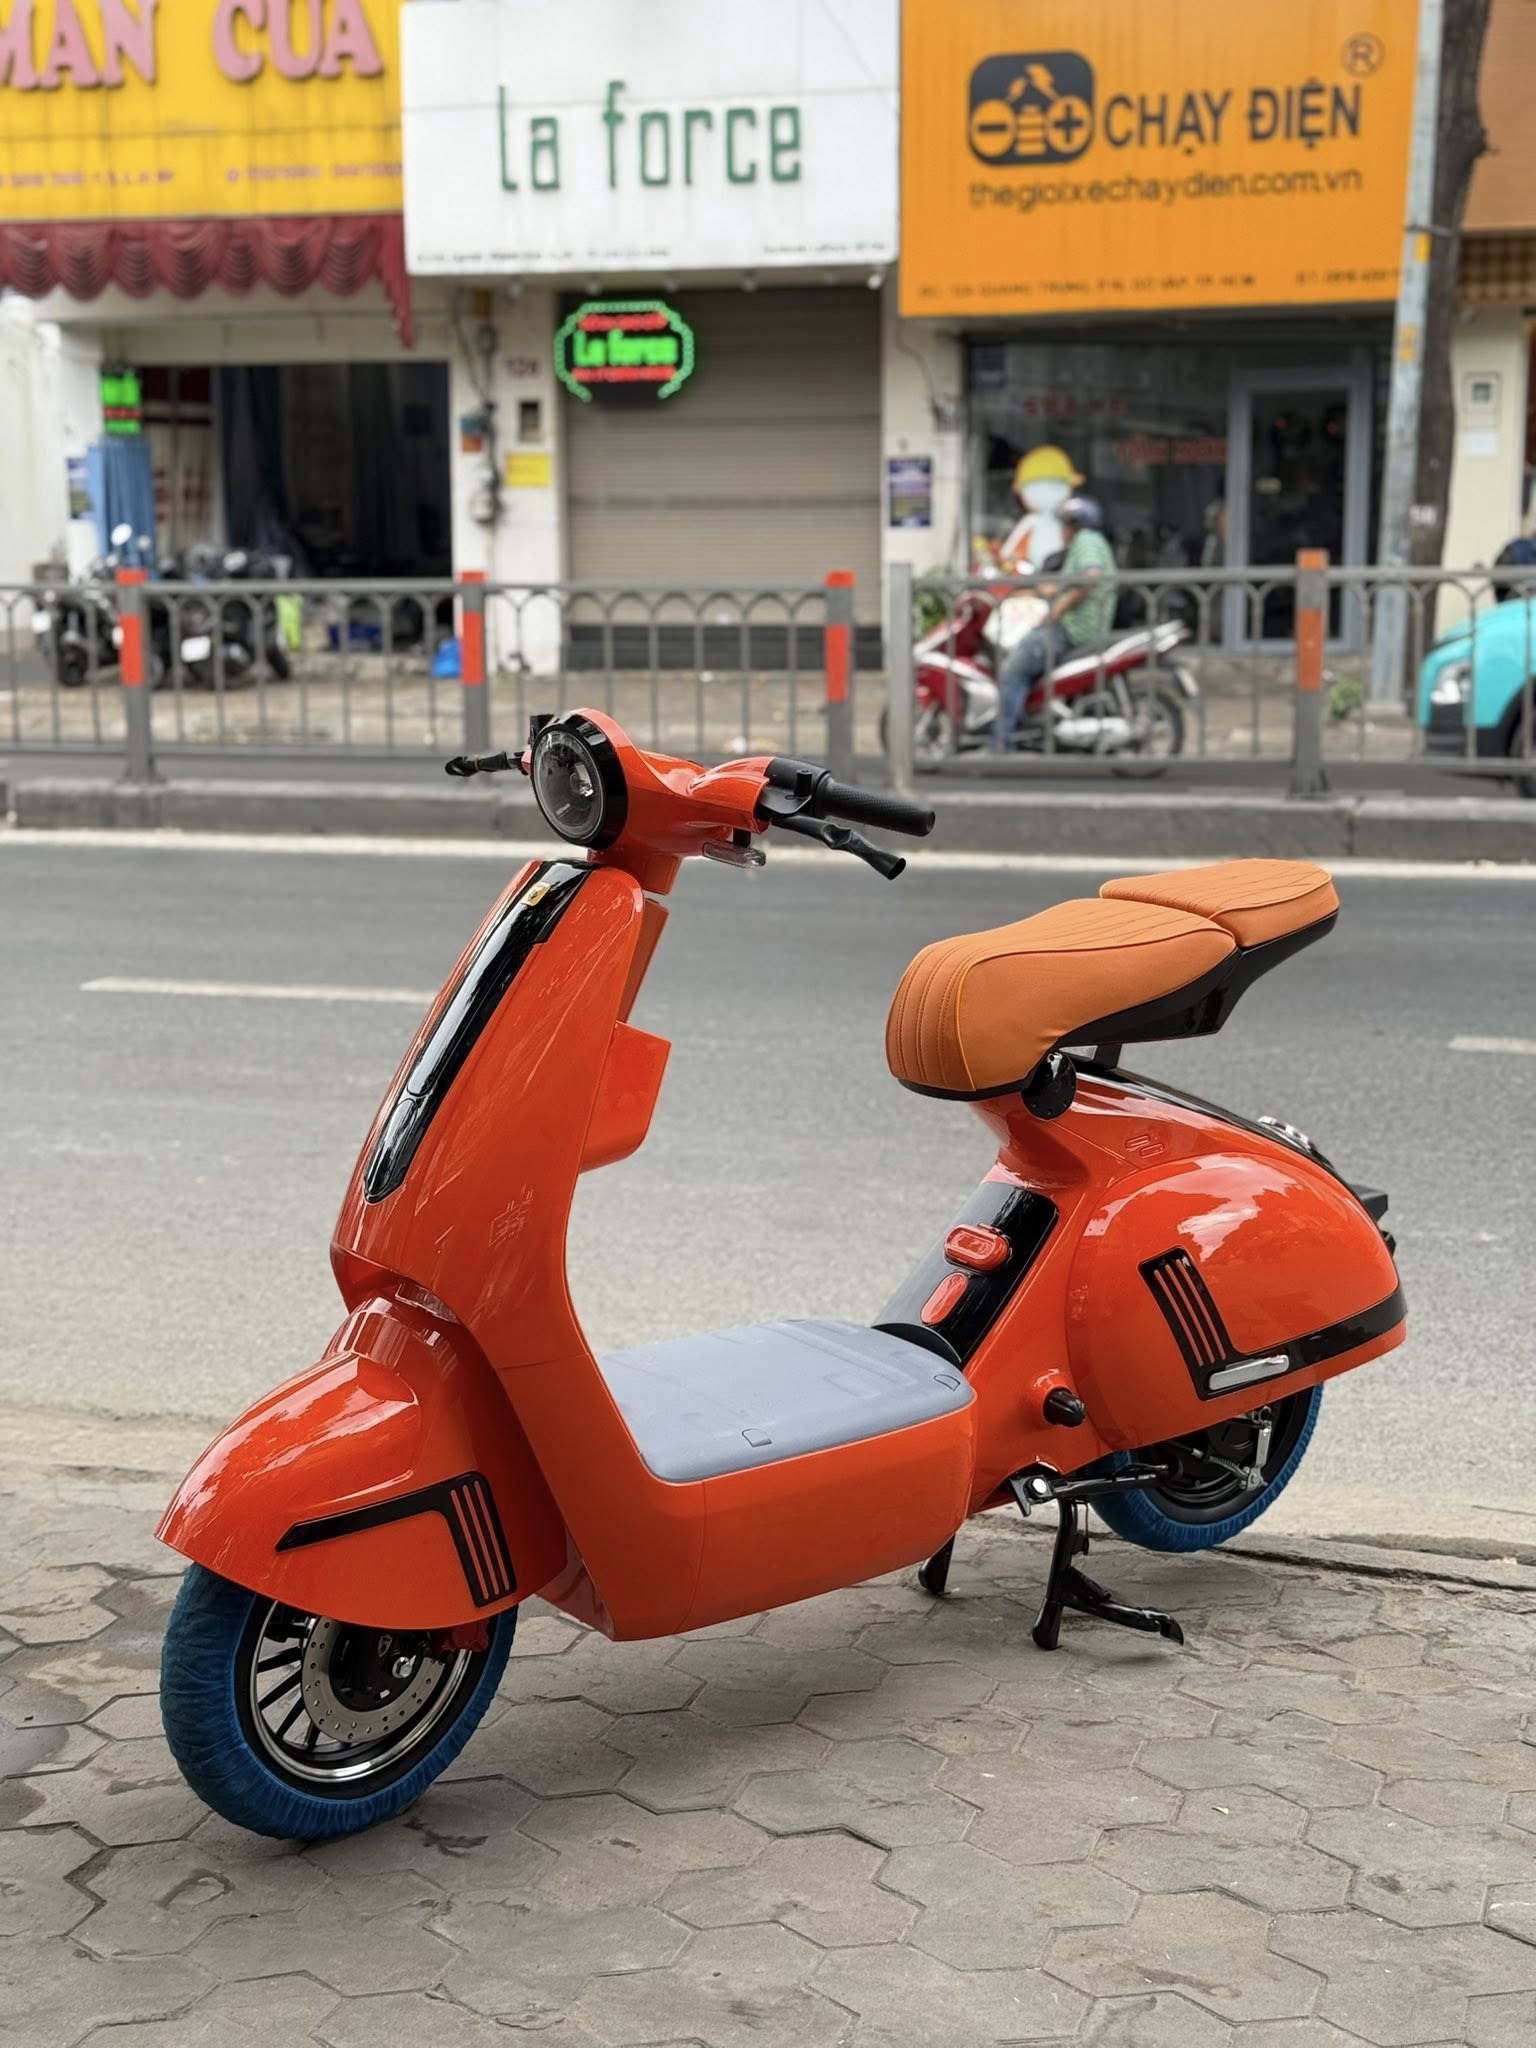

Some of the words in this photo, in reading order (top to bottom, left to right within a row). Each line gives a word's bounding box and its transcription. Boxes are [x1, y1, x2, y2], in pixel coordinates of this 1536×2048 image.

[601, 80, 802, 190] force
[1103, 90, 1232, 156] CHẠY
[1246, 78, 1362, 150] ĐIỆN
[969, 167, 1363, 213] thegioixechaydien.com.vn
